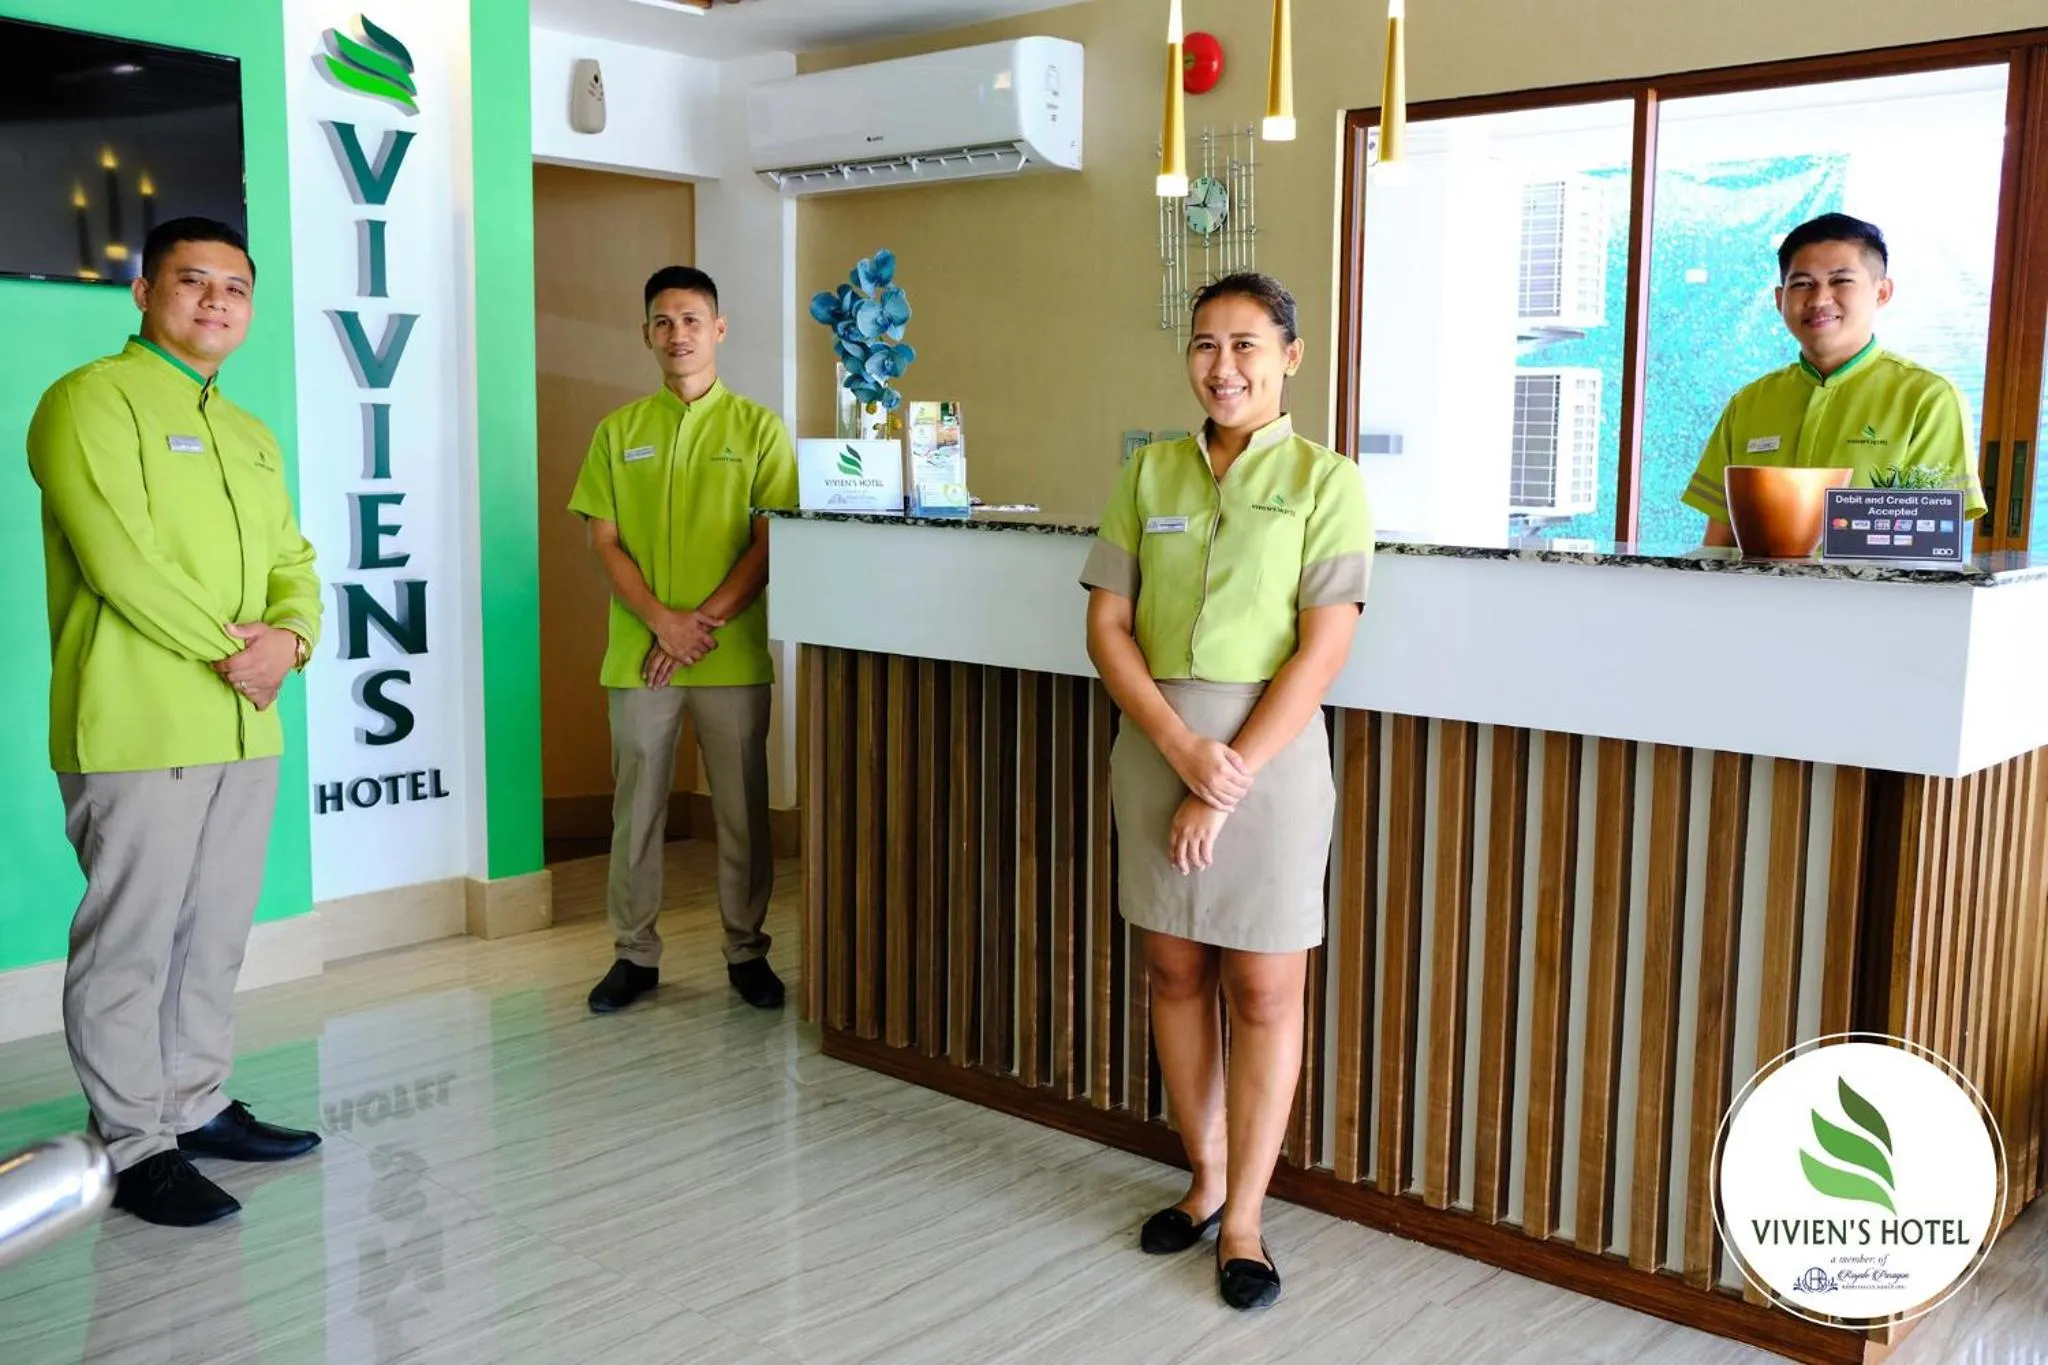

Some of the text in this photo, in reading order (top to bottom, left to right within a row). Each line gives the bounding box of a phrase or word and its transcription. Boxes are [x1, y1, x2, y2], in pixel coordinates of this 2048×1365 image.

[859, 479, 885, 488] HOTEL
[1835, 495, 1953, 506] Debit and Credit Cards
[1867, 507, 1919, 517] Accepted
[1932, 547, 1954, 556] BDO
[313, 767, 450, 815] HOTEL
